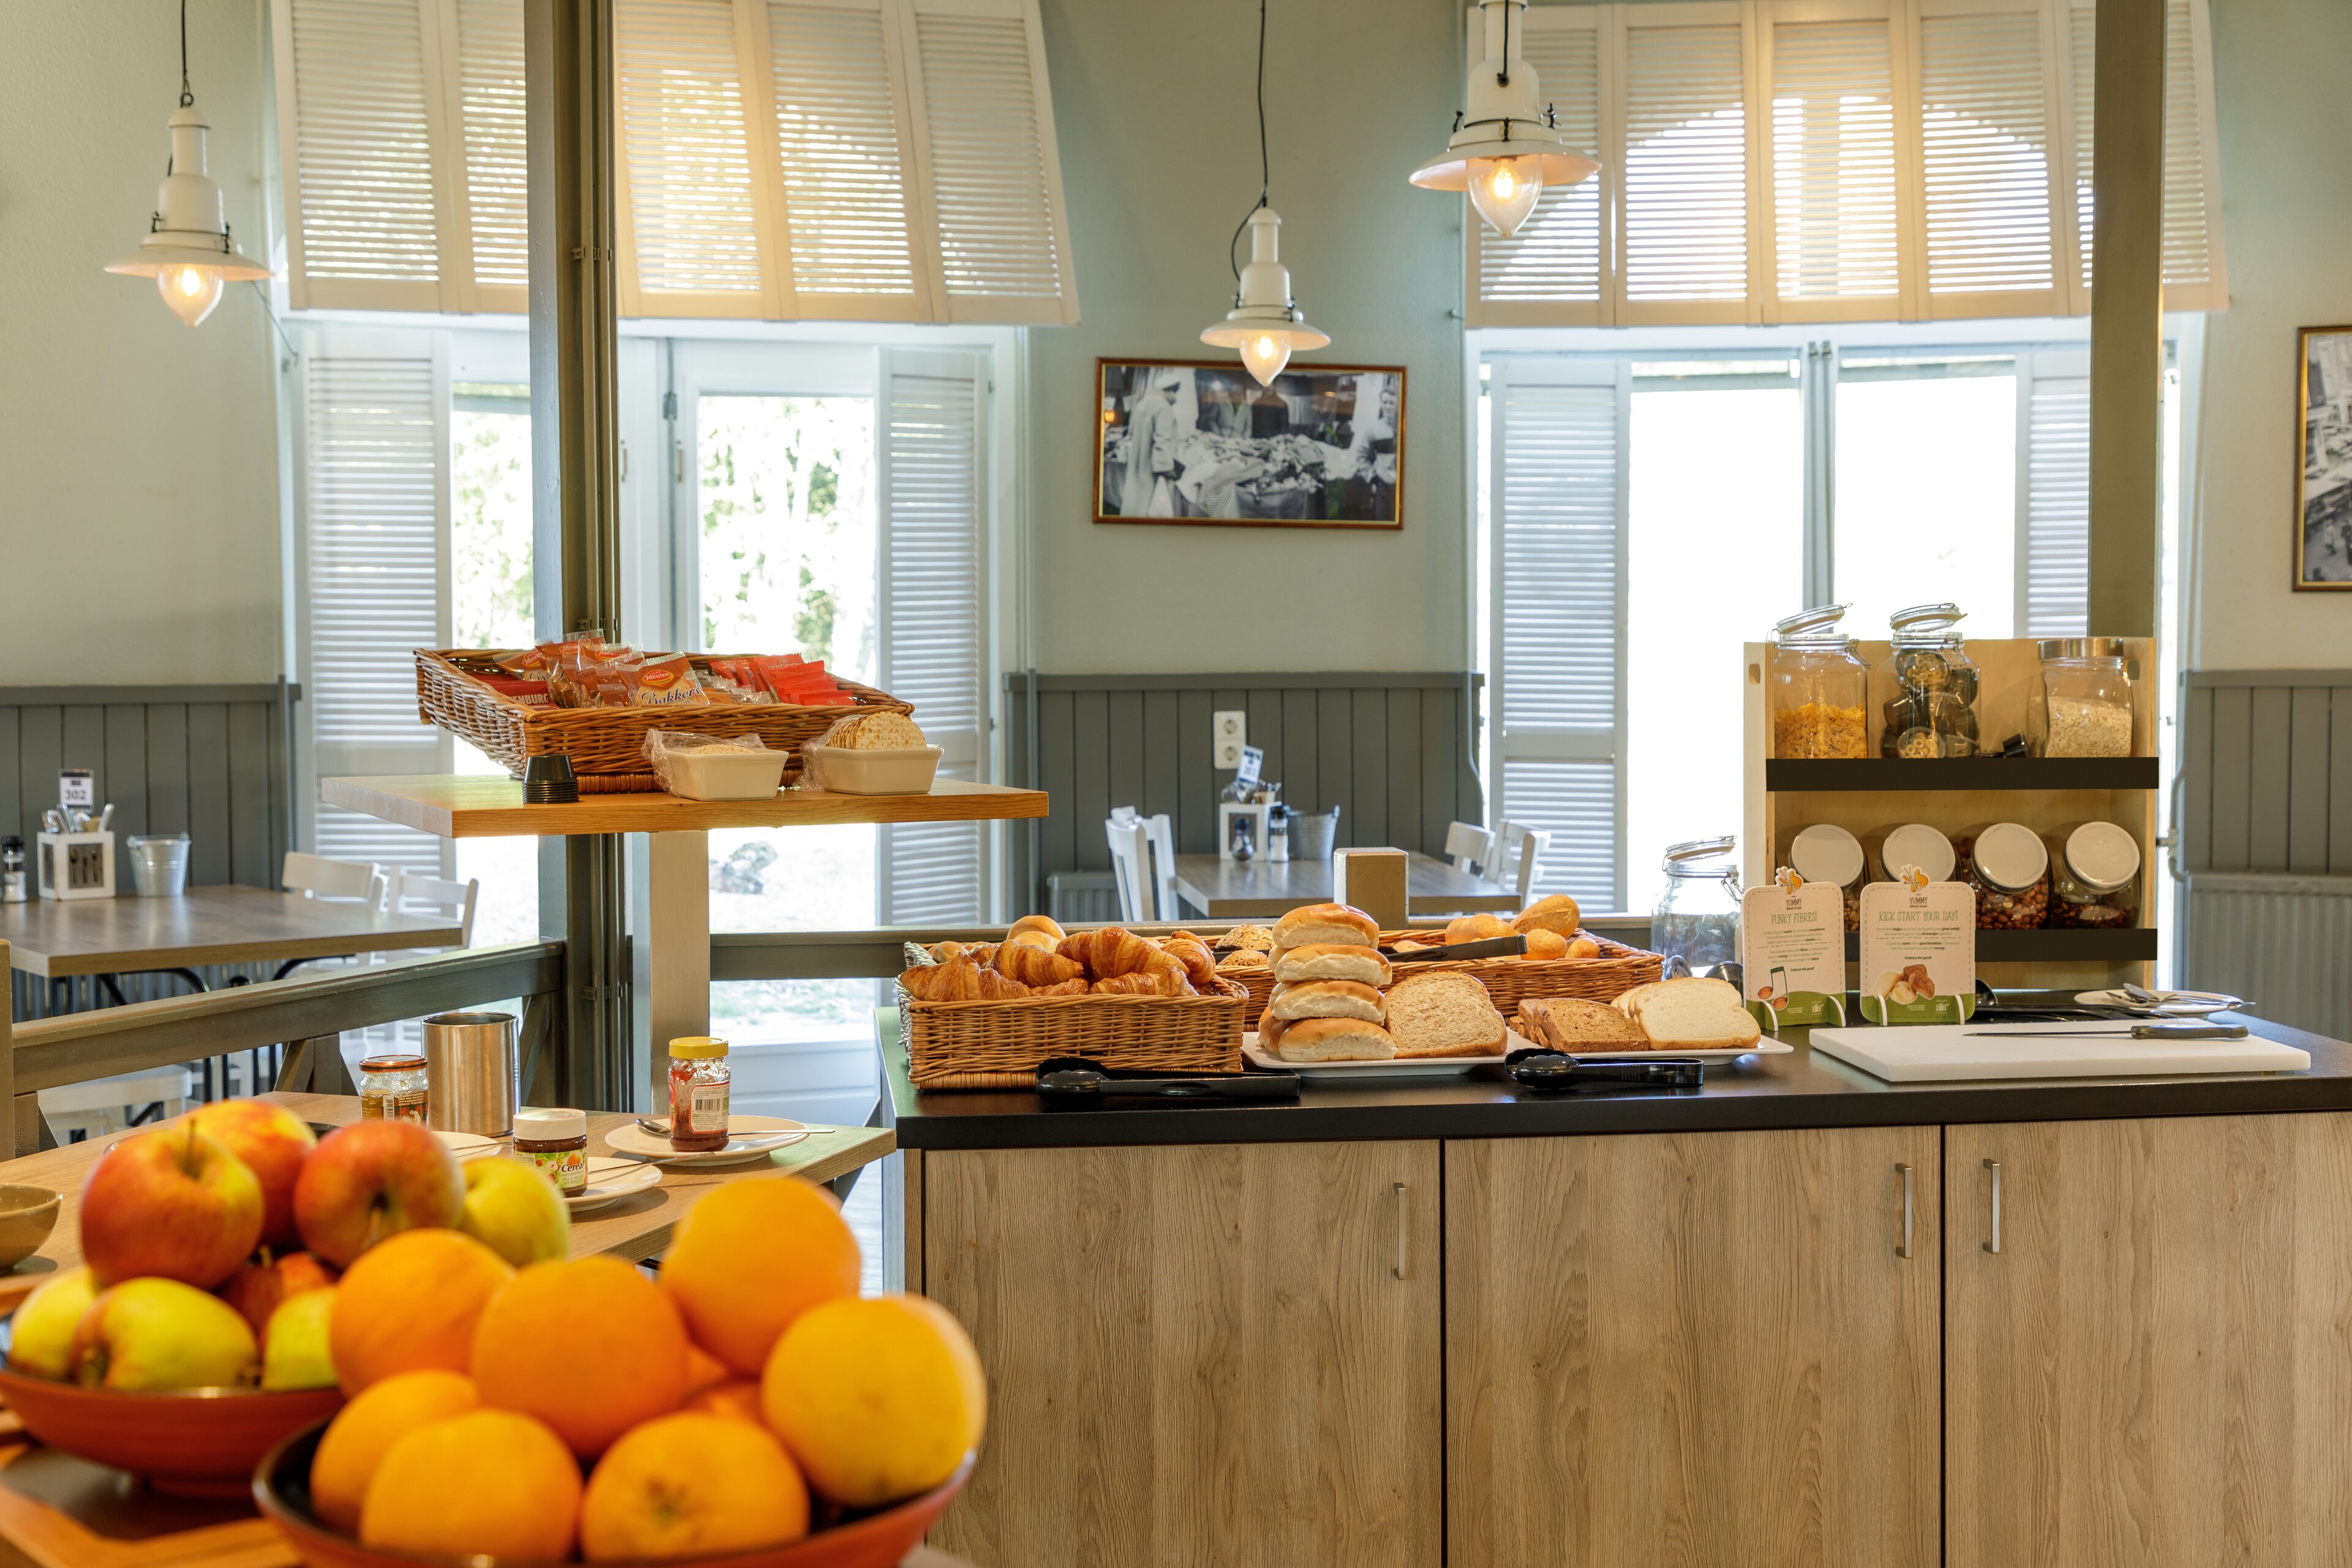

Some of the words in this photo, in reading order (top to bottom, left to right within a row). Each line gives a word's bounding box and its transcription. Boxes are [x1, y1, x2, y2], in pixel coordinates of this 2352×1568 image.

[511, 693, 549, 704] ENBURG
[641, 687, 699, 704] Bakkers
[1785, 898, 1802, 907] YUMMY
[1771, 913, 1792, 925] FUNKY
[1793, 911, 1817, 923] FIBRES!
[1879, 911, 1895, 921] KICK
[1897, 911, 1921, 921] START
[1923, 911, 1941, 921] YOUR
[1942, 910, 1958, 921] DAY!
[562, 1160, 584, 1172] Céréal
